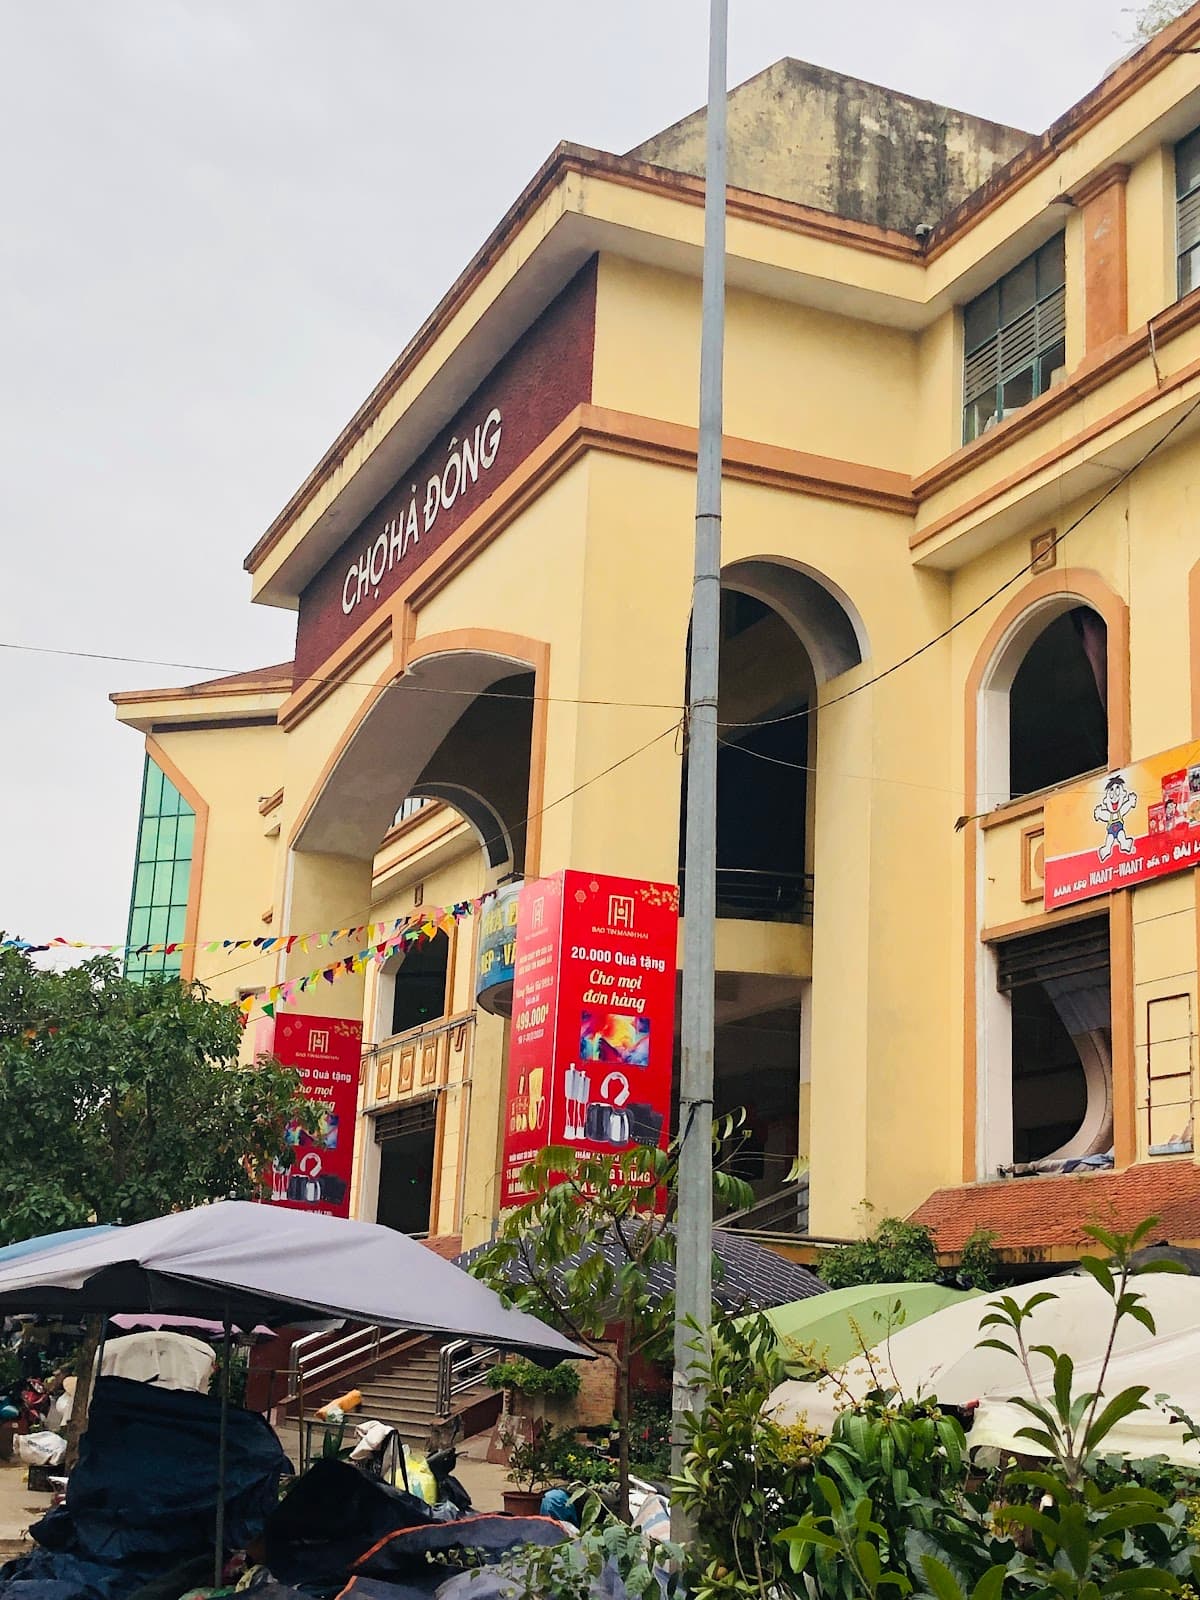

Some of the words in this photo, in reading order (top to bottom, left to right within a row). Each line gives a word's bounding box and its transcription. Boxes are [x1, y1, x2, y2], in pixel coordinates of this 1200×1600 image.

[341, 522, 389, 615] CHỢ
[388, 483, 420, 571] HÀ
[423, 408, 502, 534] ĐÔNG
[571, 946, 612, 964] 20.000
[614, 951, 637, 967] Quà
[640, 954, 666, 972] tặng
[589, 968, 615, 986] Cho
[617, 974, 643, 993] mọi
[582, 988, 608, 1006] đơn
[610, 992, 646, 1014] hàng
[312, 1069, 330, 1080] Quà
[332, 1071, 352, 1084] tặng
[314, 1085, 334, 1098] mọi
